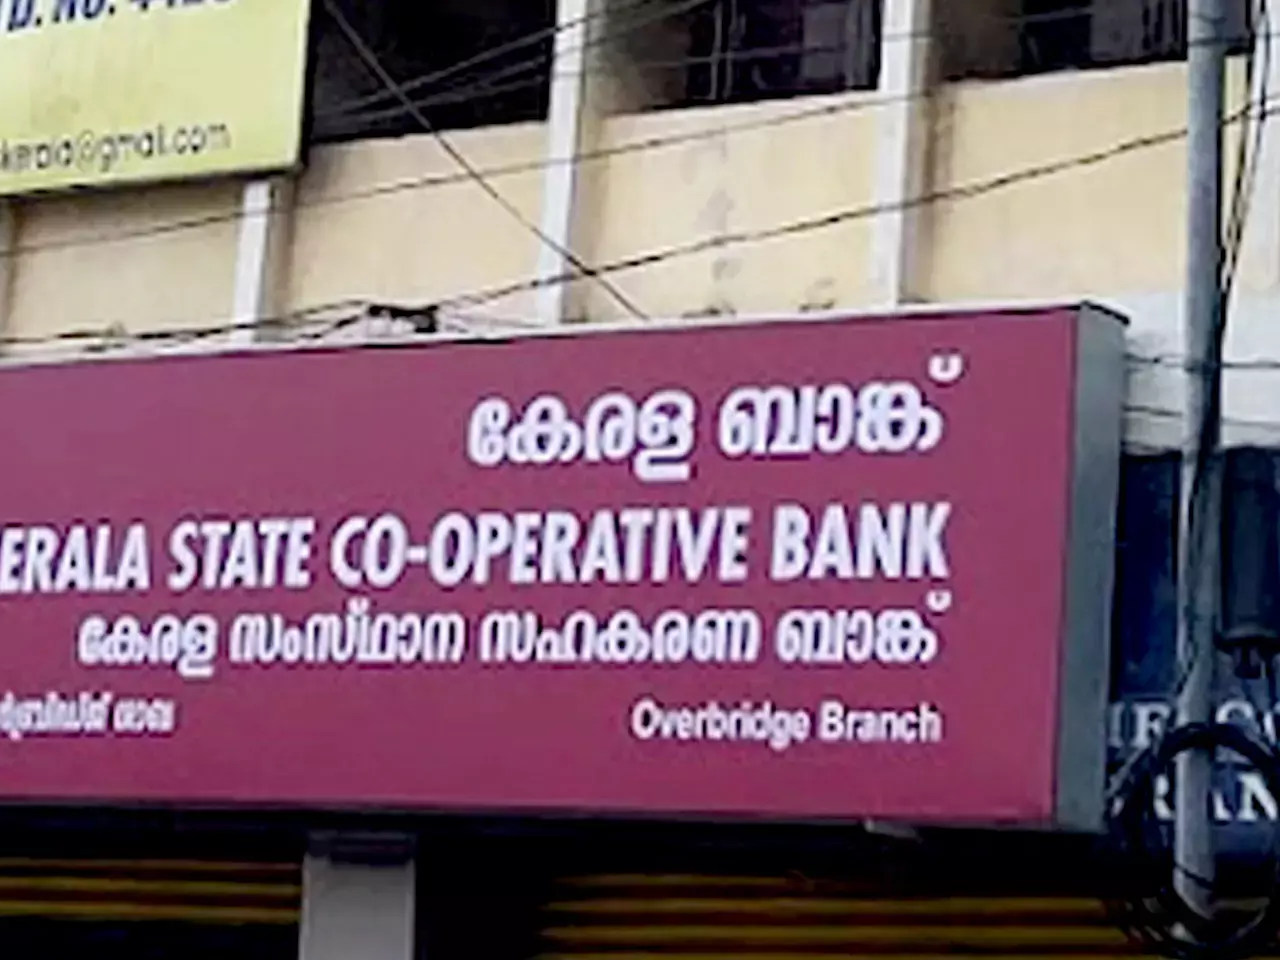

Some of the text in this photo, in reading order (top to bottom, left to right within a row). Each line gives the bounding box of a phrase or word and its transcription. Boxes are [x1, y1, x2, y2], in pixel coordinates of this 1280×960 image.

[467, 353, 962, 482] കേരള ബാങ്ക്
[167, 518, 316, 590] STATE
[329, 506, 752, 588] CO-OPERATIVE
[771, 502, 951, 581] BANK
[77, 589, 951, 677] കേരള സംസ്ഥാന സഹകരണ ബാങ്ക്
[632, 700, 942, 750] Overbridge Branch
